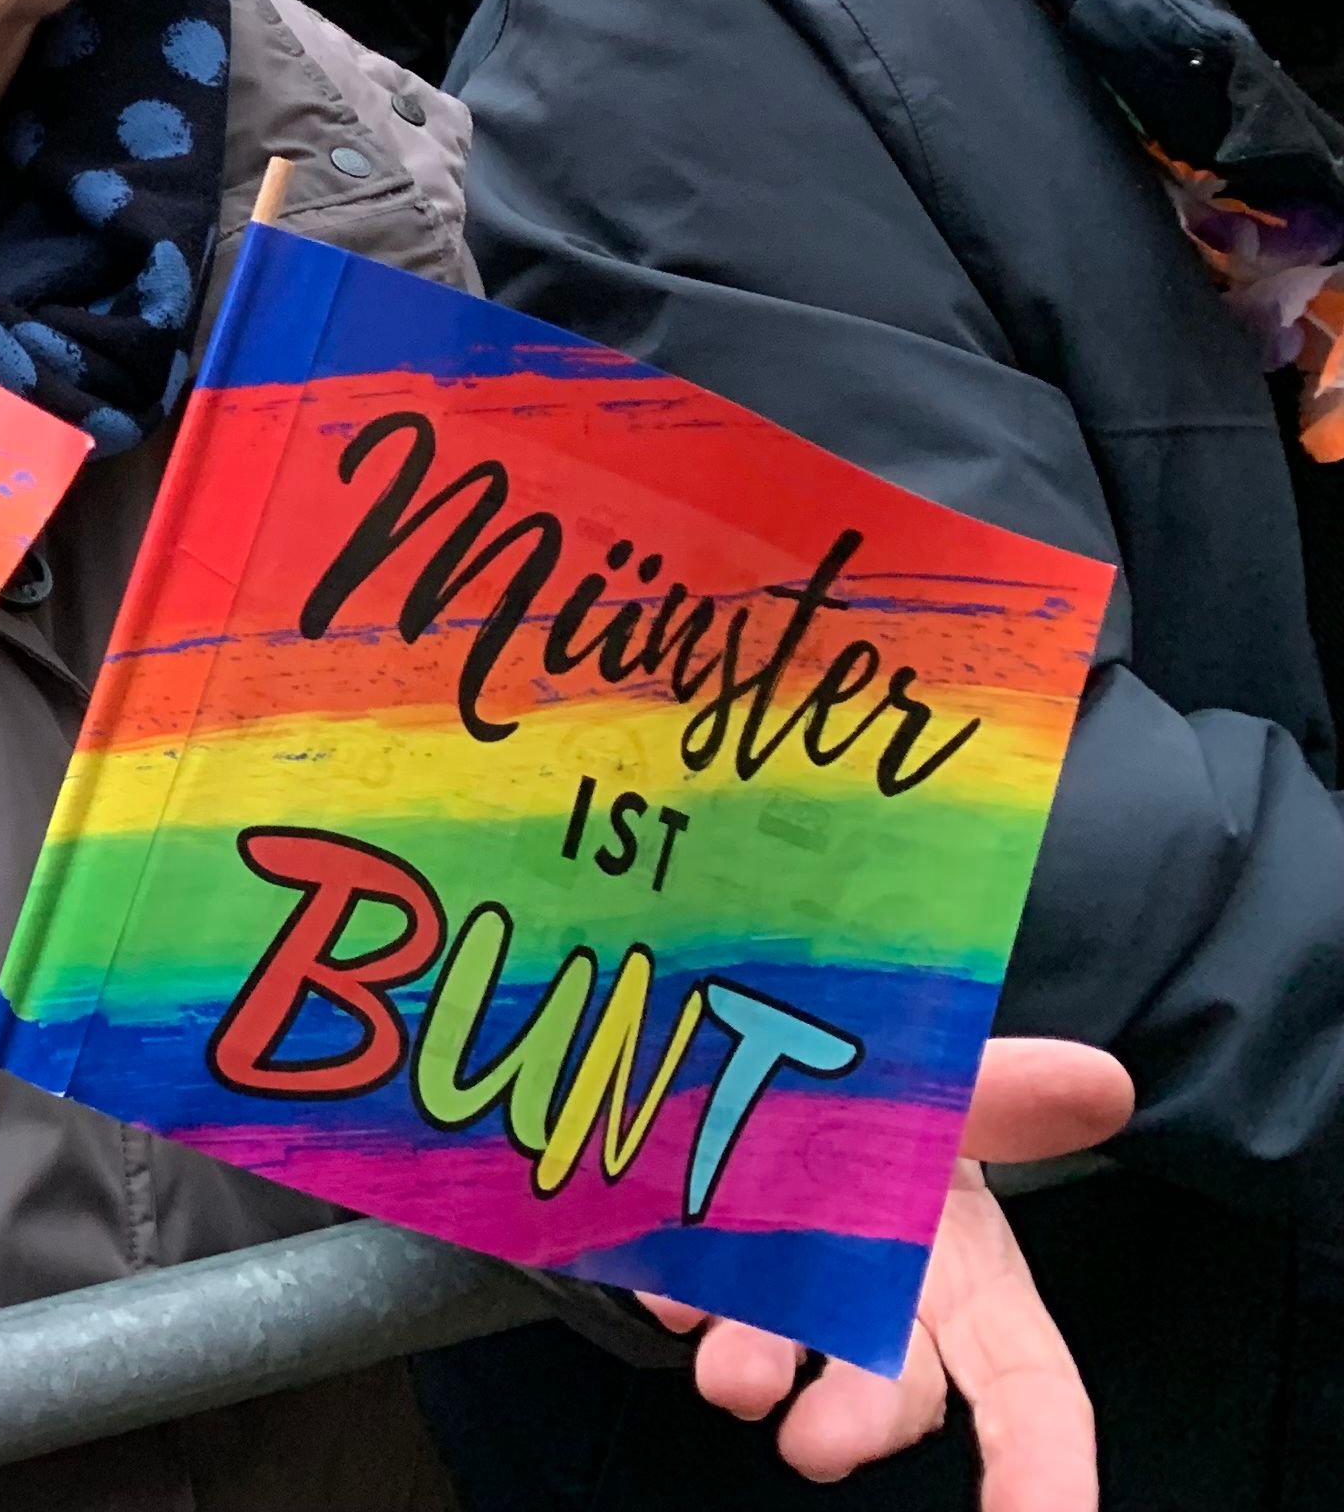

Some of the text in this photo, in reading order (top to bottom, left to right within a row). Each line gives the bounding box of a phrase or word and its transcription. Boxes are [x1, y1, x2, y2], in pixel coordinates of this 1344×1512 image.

[297, 409, 983, 799] Münster
[205, 825, 865, 1225] BUNT
[561, 776, 691, 893] IST
